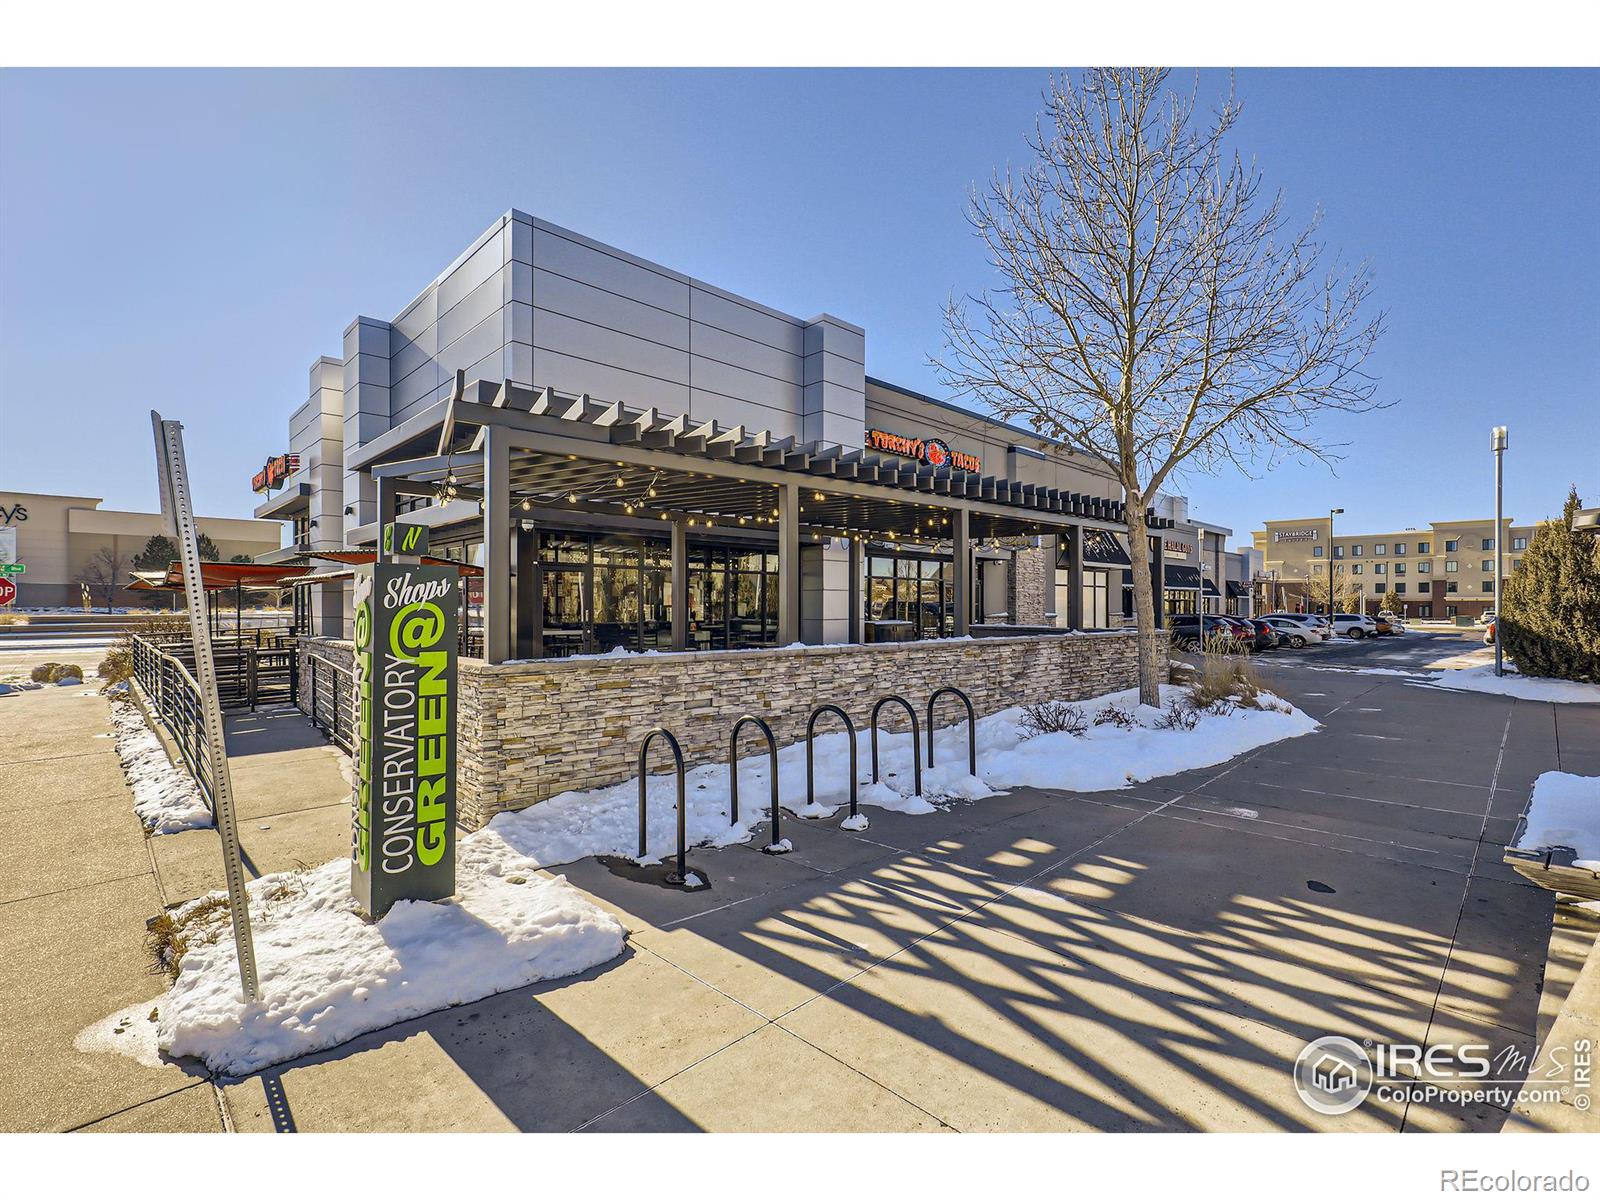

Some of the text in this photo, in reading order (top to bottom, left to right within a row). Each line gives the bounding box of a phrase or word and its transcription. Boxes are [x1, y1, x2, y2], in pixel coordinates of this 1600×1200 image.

[0, 504, 28, 524] y's
[402, 526, 423, 552] N
[383, 572, 452, 612] Shops
[381, 652, 417, 875] CONSERVATORY
[416, 650, 448, 866] GREEN
